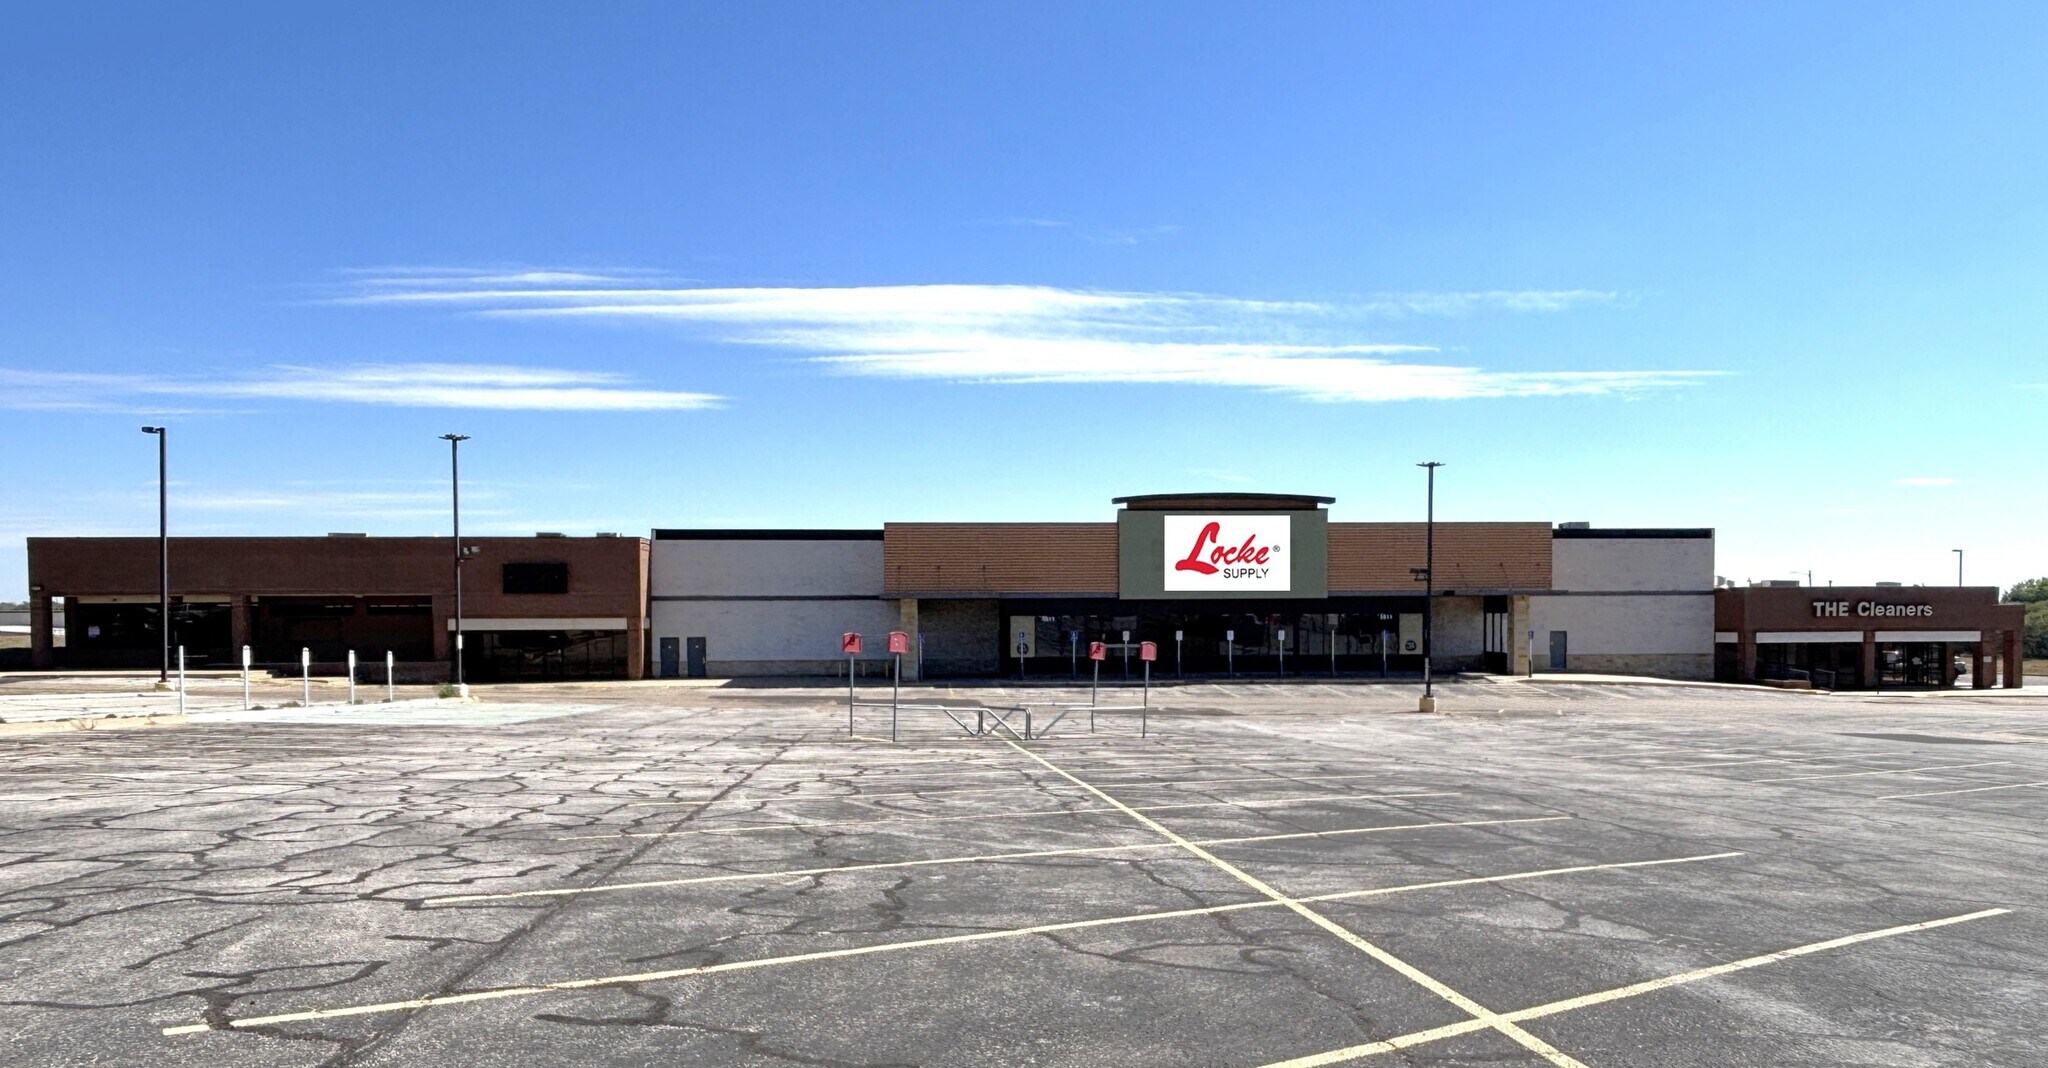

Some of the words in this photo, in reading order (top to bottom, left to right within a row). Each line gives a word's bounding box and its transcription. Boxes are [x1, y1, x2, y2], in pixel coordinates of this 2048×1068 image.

[1175, 522, 1270, 575] Locke
[1223, 568, 1269, 579] SUPPLY
[1813, 601, 1850, 617] THE
[1857, 601, 1934, 617] Cleaners
